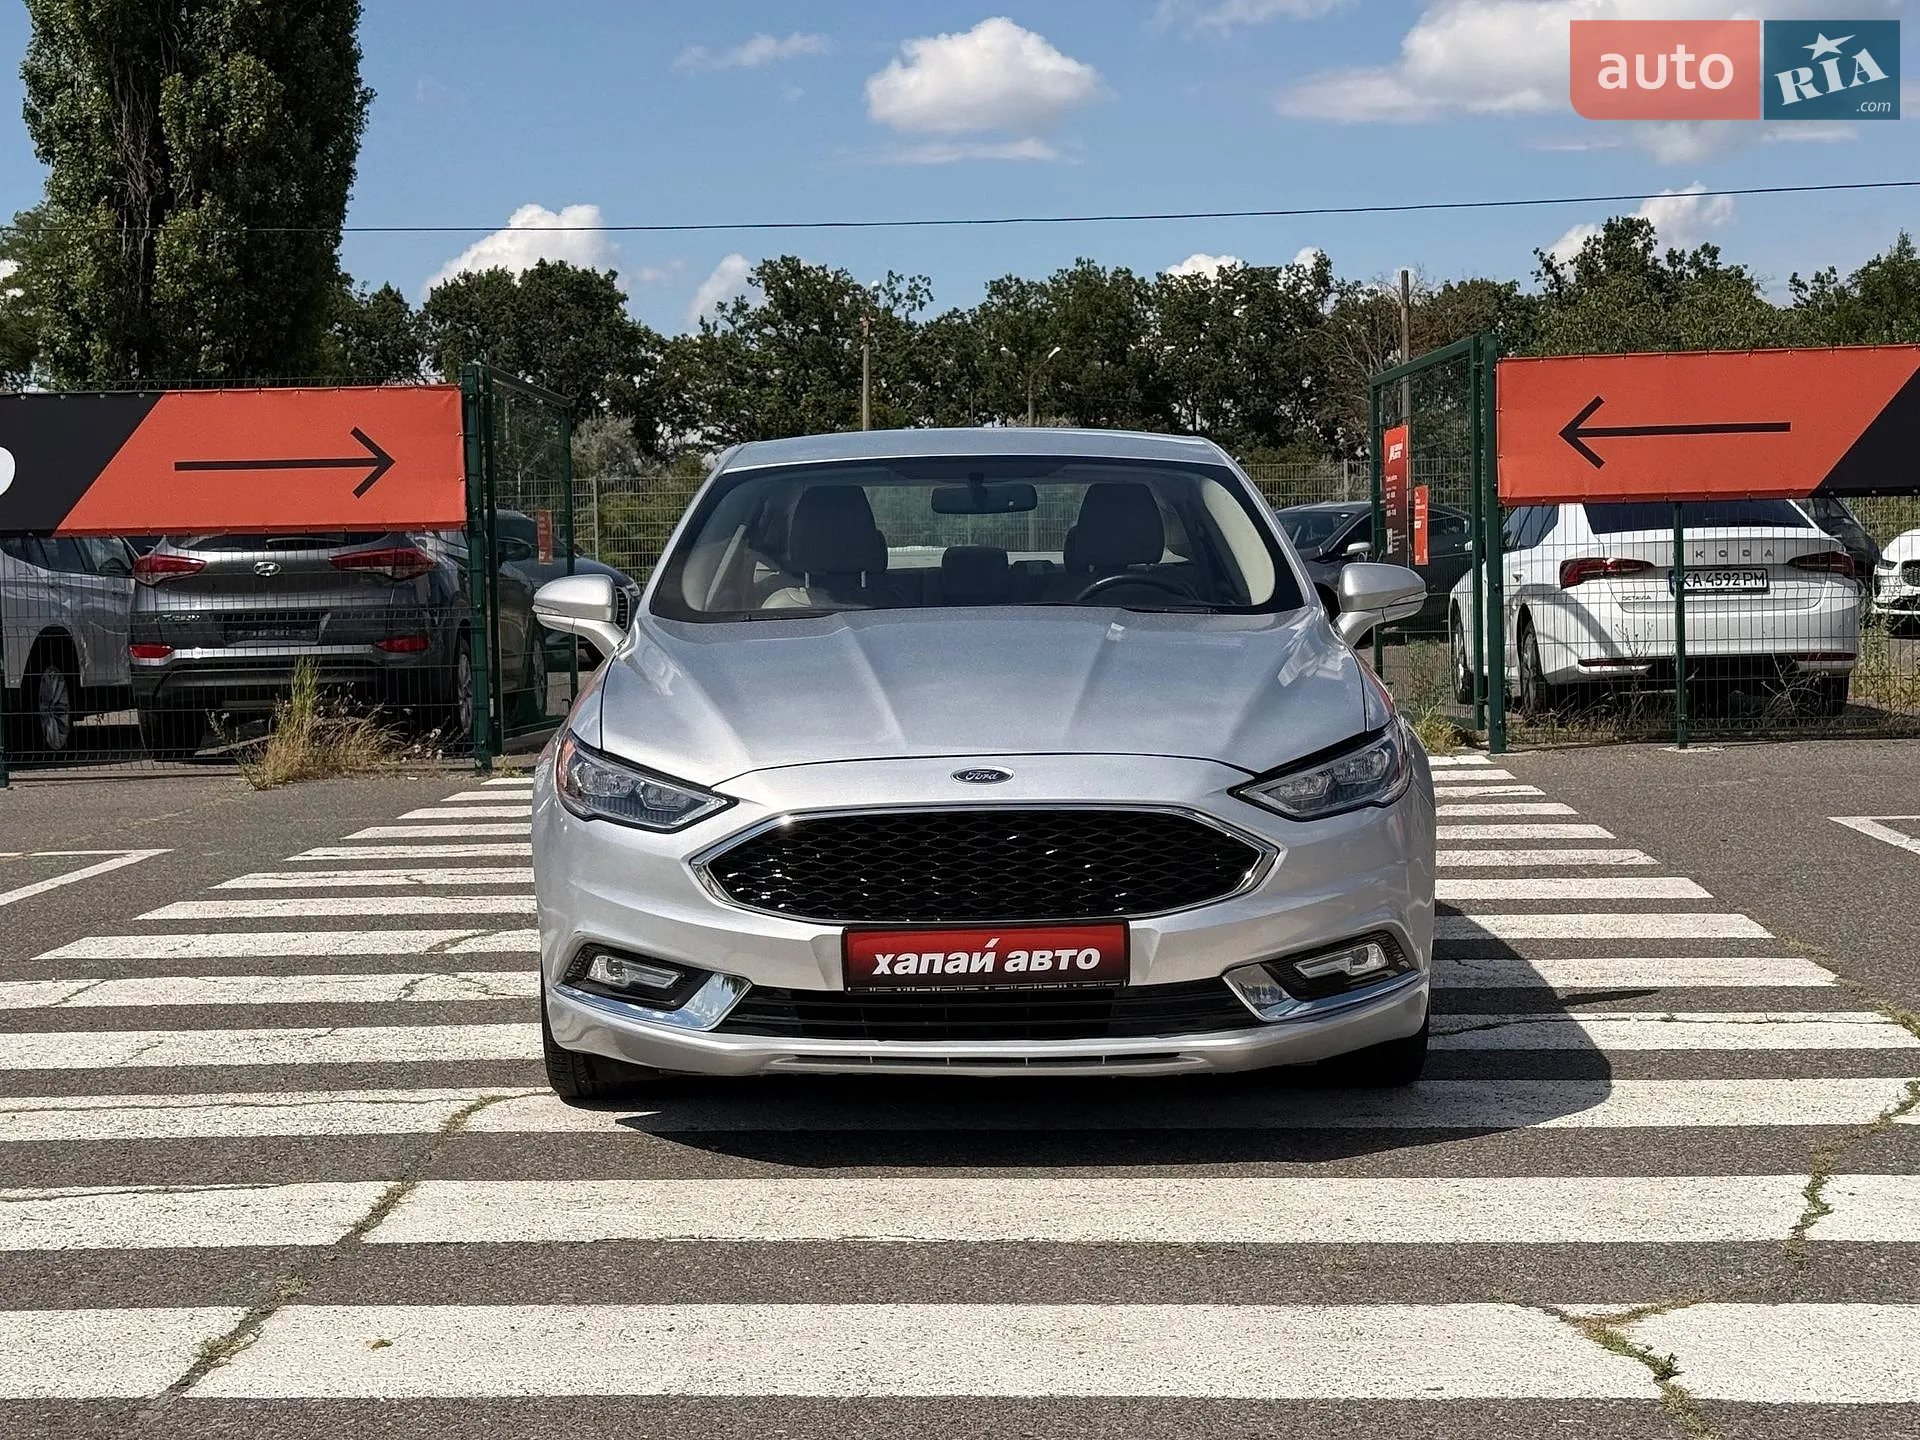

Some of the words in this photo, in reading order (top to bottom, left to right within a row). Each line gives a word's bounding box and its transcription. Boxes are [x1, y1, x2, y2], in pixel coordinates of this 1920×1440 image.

[1693, 548, 1774, 559] KODA
[1705, 571, 1740, 588] 4592
[965, 770, 999, 781] Ford
[871, 937, 1001, 976] хапай
[1003, 947, 1101, 972] авто
